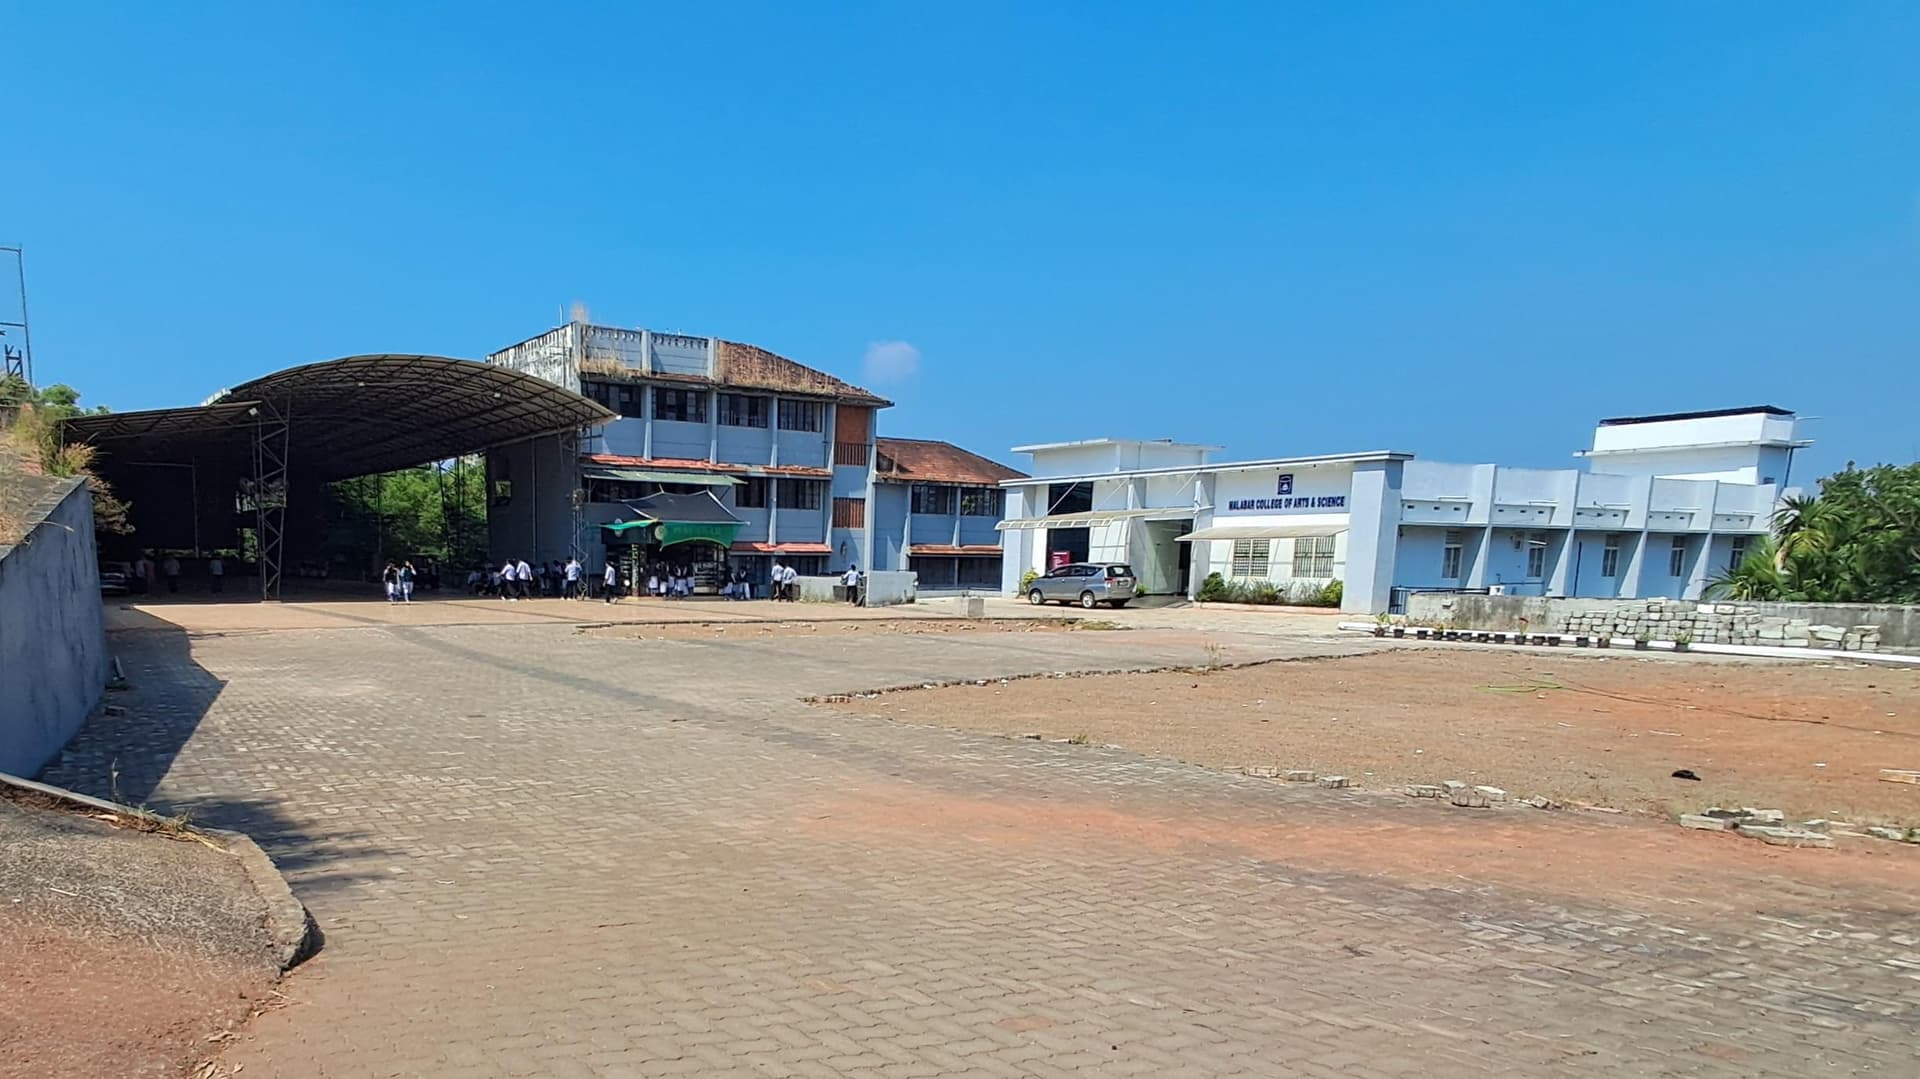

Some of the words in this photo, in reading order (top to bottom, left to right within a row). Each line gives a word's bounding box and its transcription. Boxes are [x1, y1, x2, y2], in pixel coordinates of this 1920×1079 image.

[1256, 498, 1283, 509] COLLEGE
[1284, 498, 1292, 508] OF
[1293, 497, 1309, 508] ARTS
[1311, 497, 1315, 507] &
[1317, 496, 1345, 507] SCIENCE
